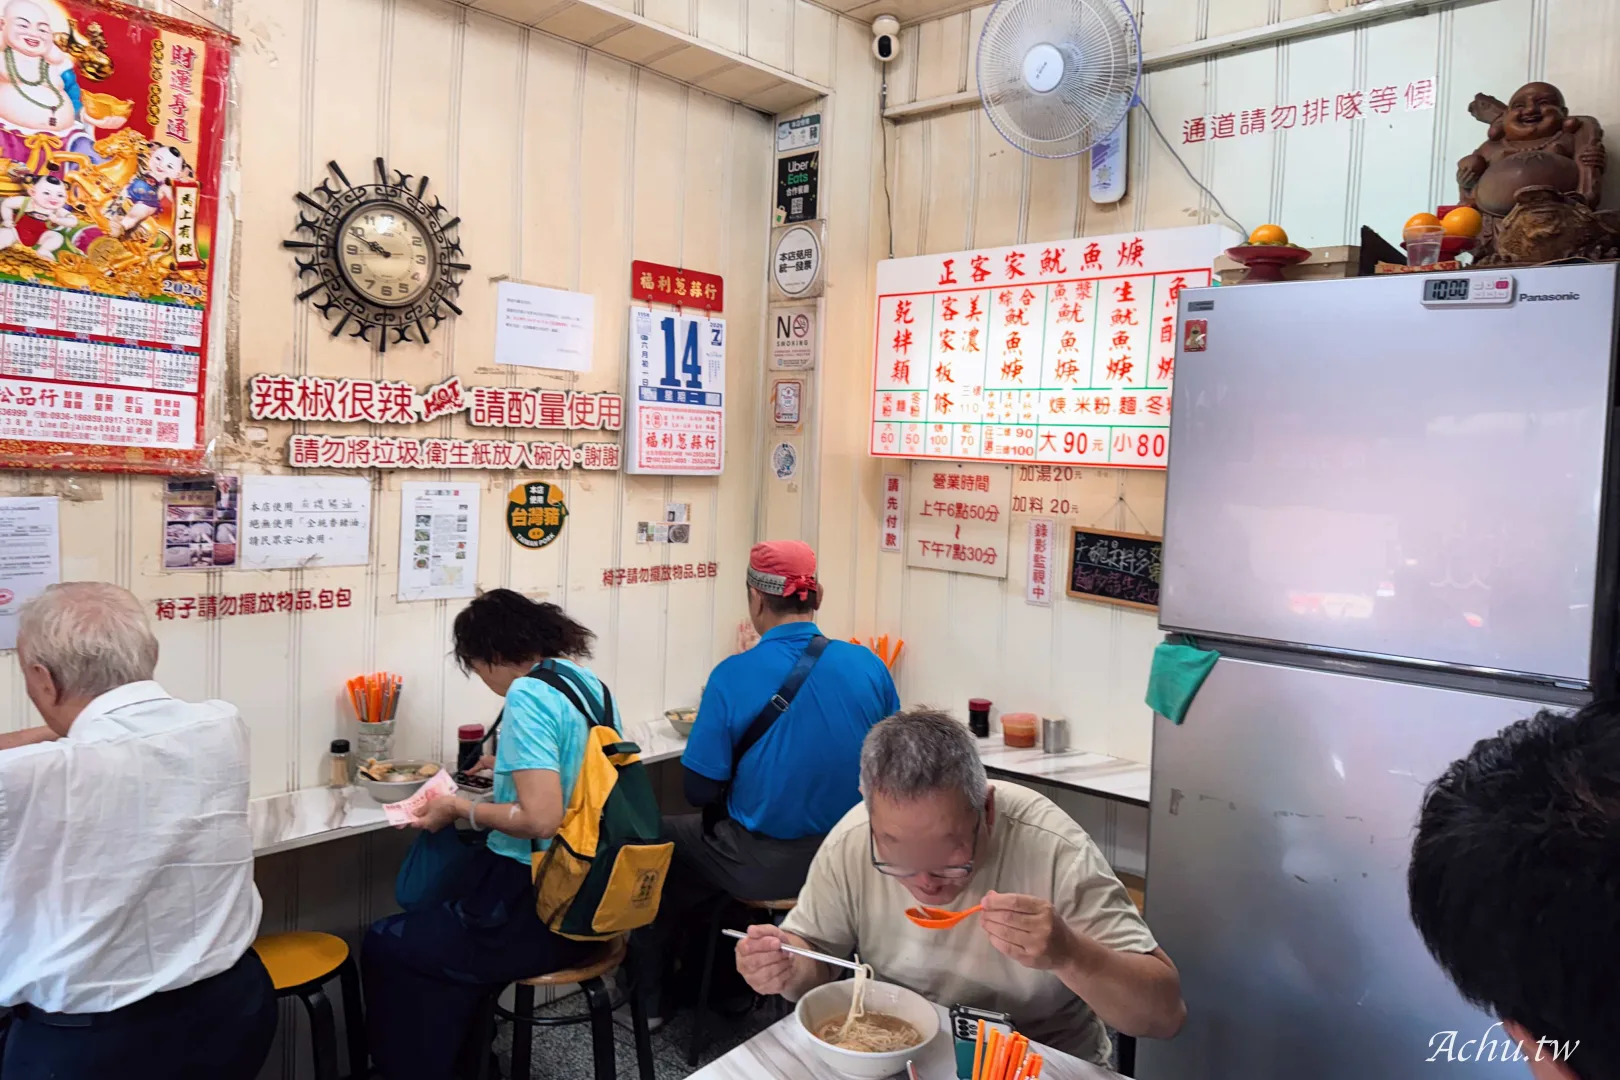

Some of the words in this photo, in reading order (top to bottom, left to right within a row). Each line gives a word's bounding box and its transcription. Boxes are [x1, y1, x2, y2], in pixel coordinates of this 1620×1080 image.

[1182, 80, 1433, 144] 通道請勿排隊等候
[787, 160, 809, 172] Uber
[787, 173, 809, 185] Eats
[178, 191, 194, 258] 馬上有錢
[938, 236, 1144, 285] 正客家魷魚焿
[163, 280, 203, 298] 2026
[999, 288, 1035, 307] 綜合
[1519, 292, 1580, 302] Panasonic
[961, 295, 983, 353] 美濃
[711, 329, 720, 342] 7
[776, 339, 808, 347] SMOKING
[891, 300, 914, 385] 乾拌類
[660, 316, 703, 389] 14
[255, 375, 414, 422] 辣椒很辣
[423, 379, 464, 419] HOT
[474, 389, 622, 428] 請酌量使用
[880, 433, 894, 443] 60
[905, 434, 919, 444] 50
[930, 436, 948, 445] 100
[960, 436, 975, 445] 70
[529, 485, 545, 495] 本店
[932, 473, 990, 492] 營業時間
[529, 495, 545, 504] 使用
[511, 507, 559, 526] 台灣豬
[885, 478, 898, 547] 請先付款
[919, 500, 999, 522] 上午6點50分
[538, 533, 555, 547] PORK
[918, 540, 997, 564] 下午7點30分
[1033, 523, 1047, 600] 錄影監視中
